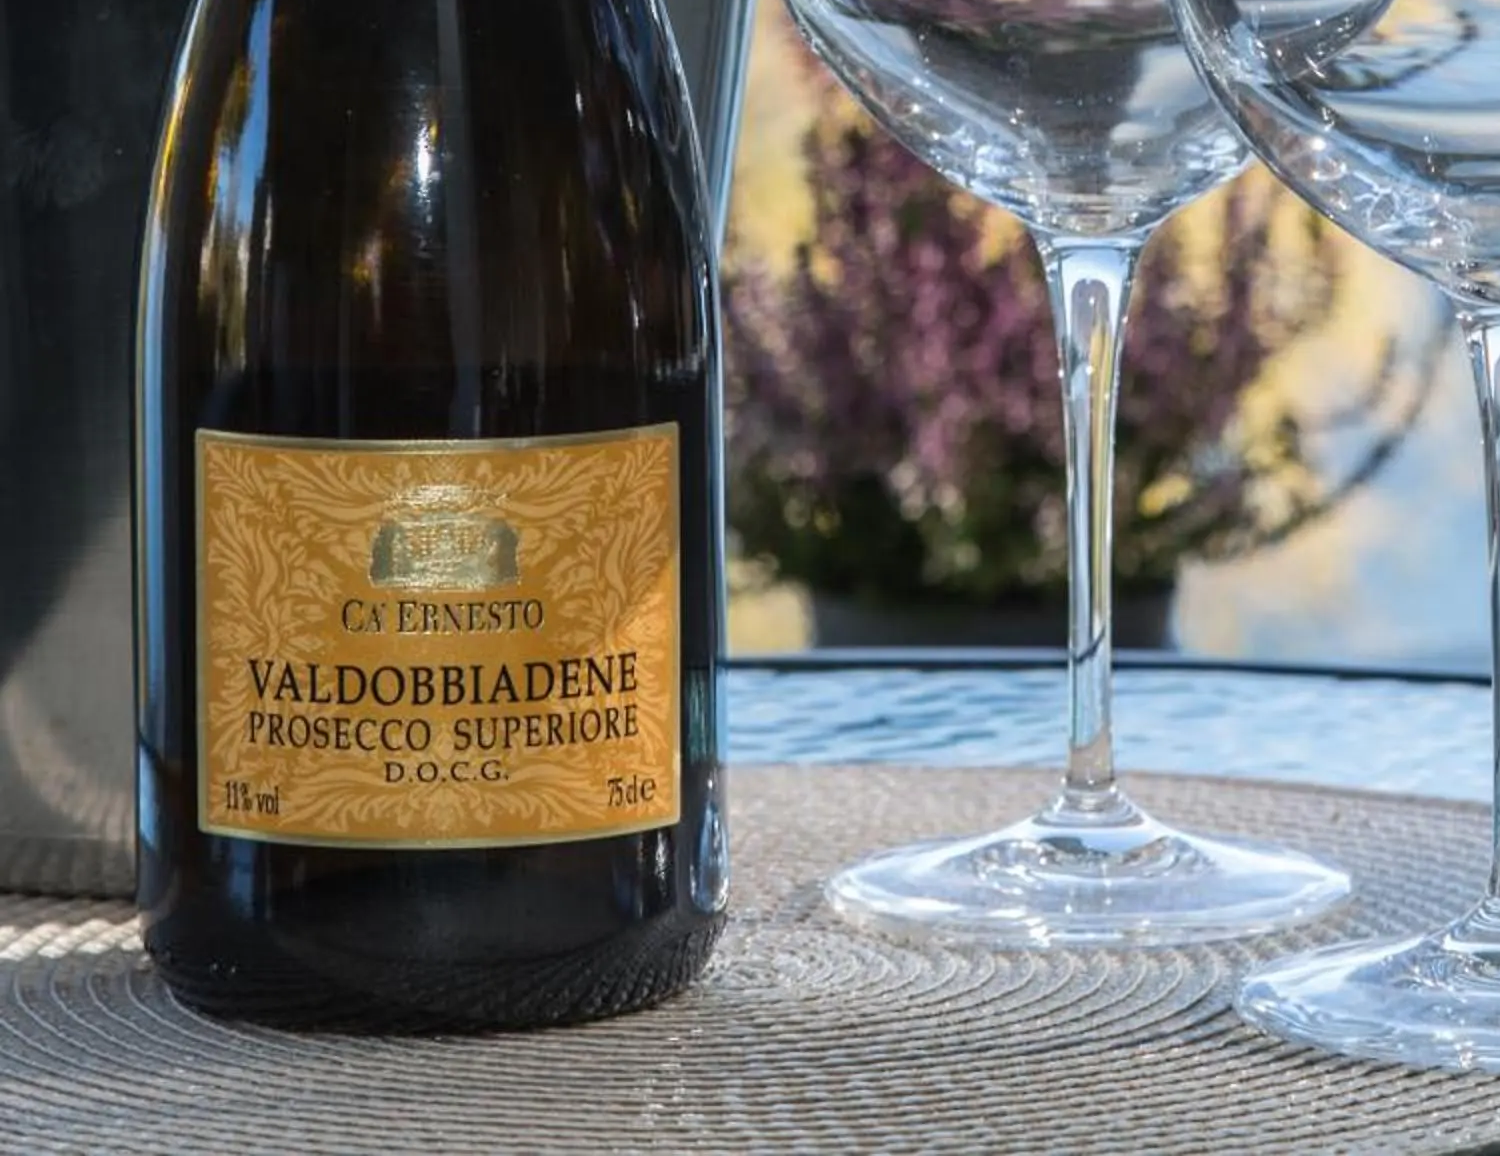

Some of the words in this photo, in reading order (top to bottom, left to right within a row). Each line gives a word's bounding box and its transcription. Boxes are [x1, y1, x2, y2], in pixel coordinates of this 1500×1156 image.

[397, 599, 545, 634] ERNESTO
[248, 652, 638, 706] VALDOBBIADENE
[248, 709, 432, 751] PROSECCO
[452, 704, 639, 751] SUPERIORE
[384, 760, 510, 783] D.O.C.G.
[255, 785, 279, 815] vol
